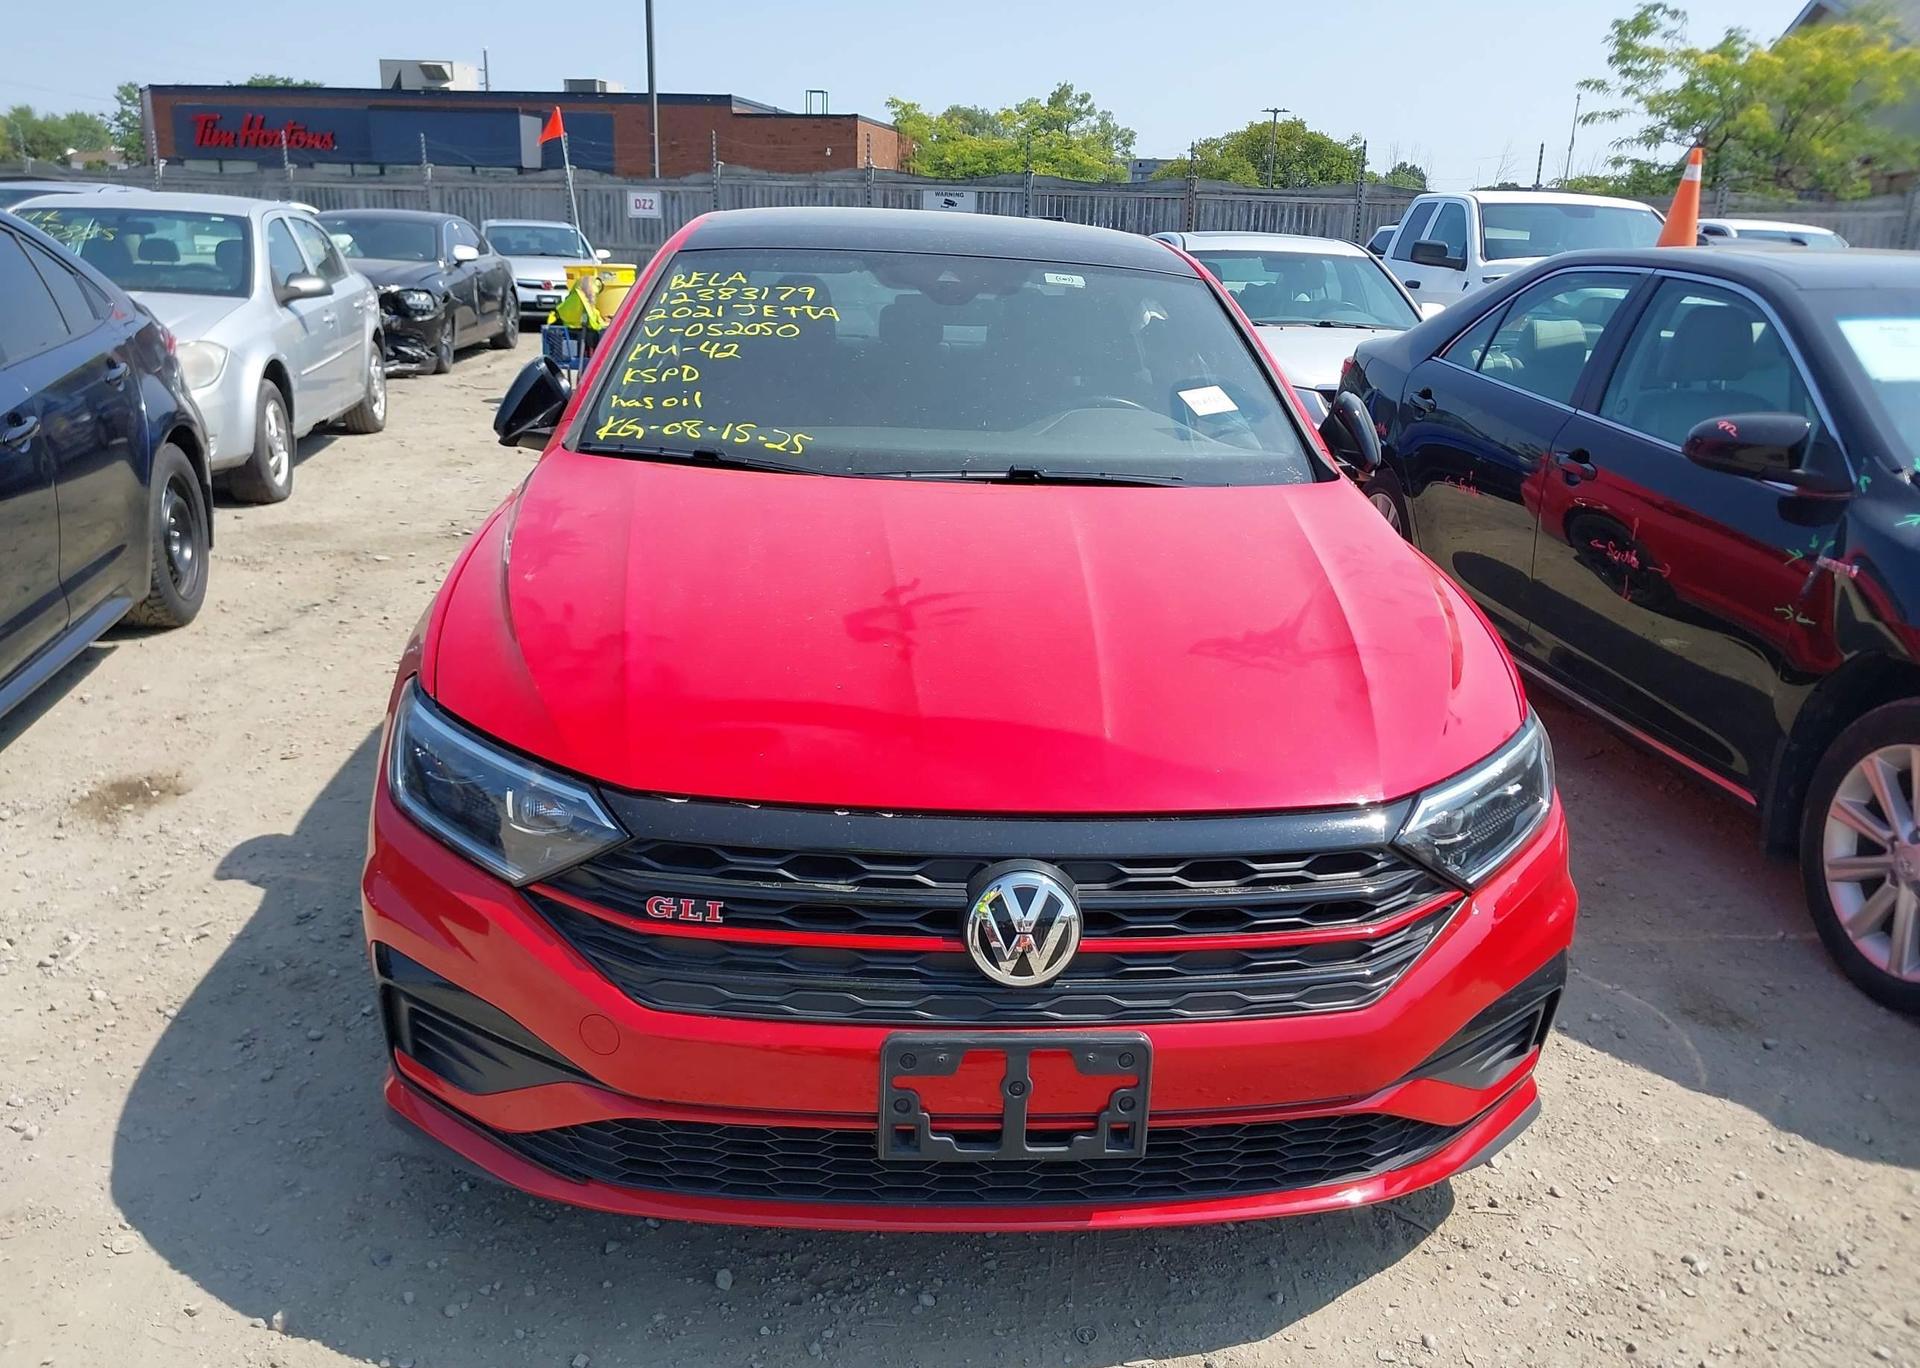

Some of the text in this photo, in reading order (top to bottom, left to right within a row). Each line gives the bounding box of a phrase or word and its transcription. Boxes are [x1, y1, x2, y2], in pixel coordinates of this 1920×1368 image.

[192, 112, 335, 150] Tim Hortons
[634, 198, 655, 210] DZ2
[670, 272, 748, 290] BELA
[659, 286, 816, 304] 12383179
[644, 304, 841, 322] 2021 JETTA
[643, 322, 800, 338] V-052050
[627, 340, 742, 362] KM-42
[622, 365, 699, 385] KSPD
[611, 390, 702, 409] has oil
[646, 896, 724, 923] GLI
